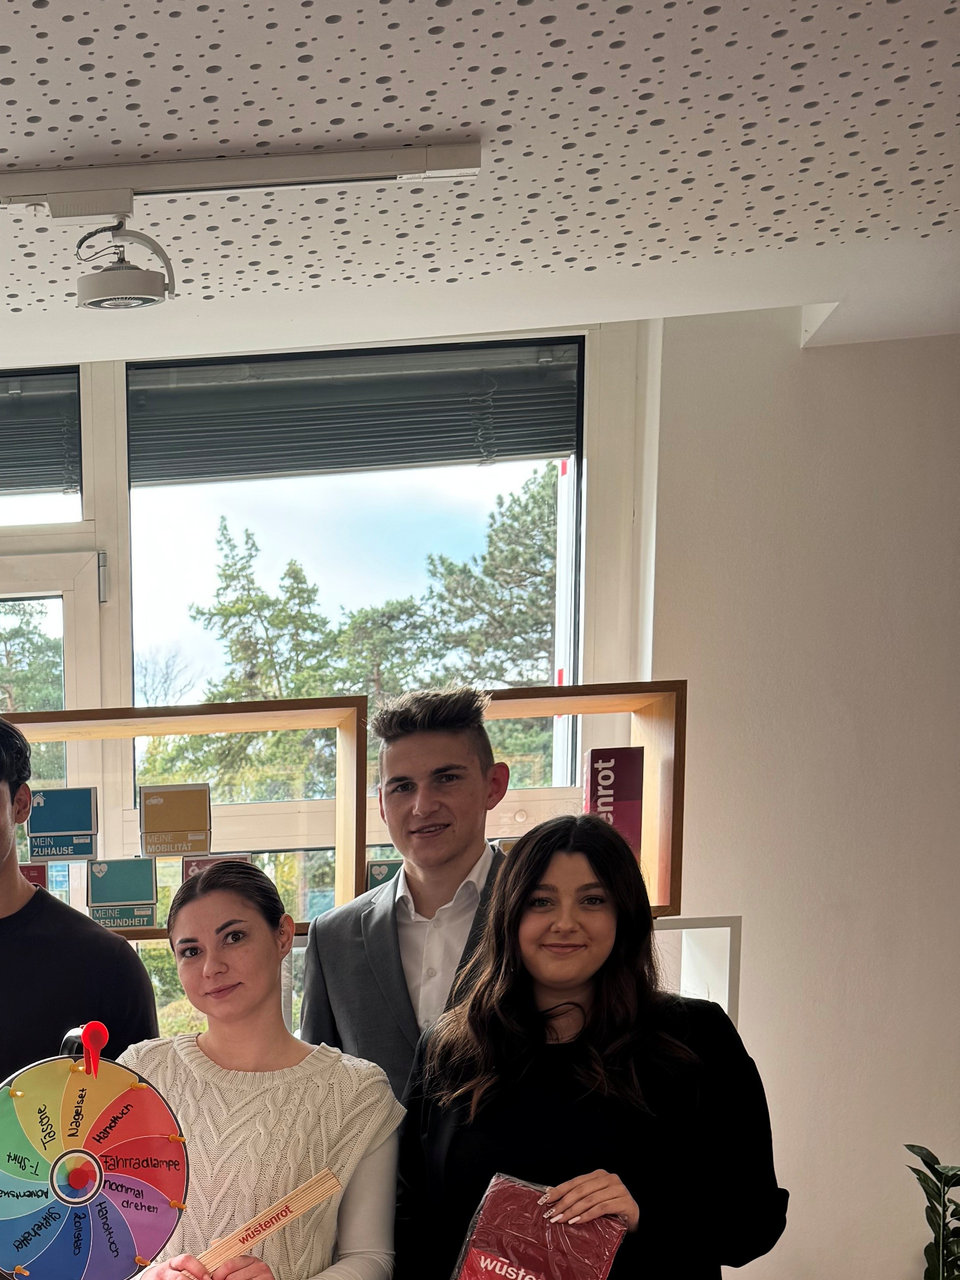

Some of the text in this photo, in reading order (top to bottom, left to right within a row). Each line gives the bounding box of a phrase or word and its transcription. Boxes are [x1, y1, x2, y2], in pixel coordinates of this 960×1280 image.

[593, 758, 616, 825] enrot
[32, 837, 54, 847] MEIN
[147, 834, 174, 844] MEINE
[32, 846, 74, 856] ZUHAUSE
[146, 843, 193, 854] MOBILITÄT
[93, 909, 121, 918] MEINE
[67, 1087, 88, 1138] Nagelset
[37, 1103, 56, 1151] Tasche
[91, 1103, 134, 1145] Handtuch
[6, 1151, 40, 1177] T-Shirt
[100, 1154, 181, 1172] Fahrradlampe
[121, 1199, 159, 1214] drehen
[96, 1200, 120, 1258] Handtuch
